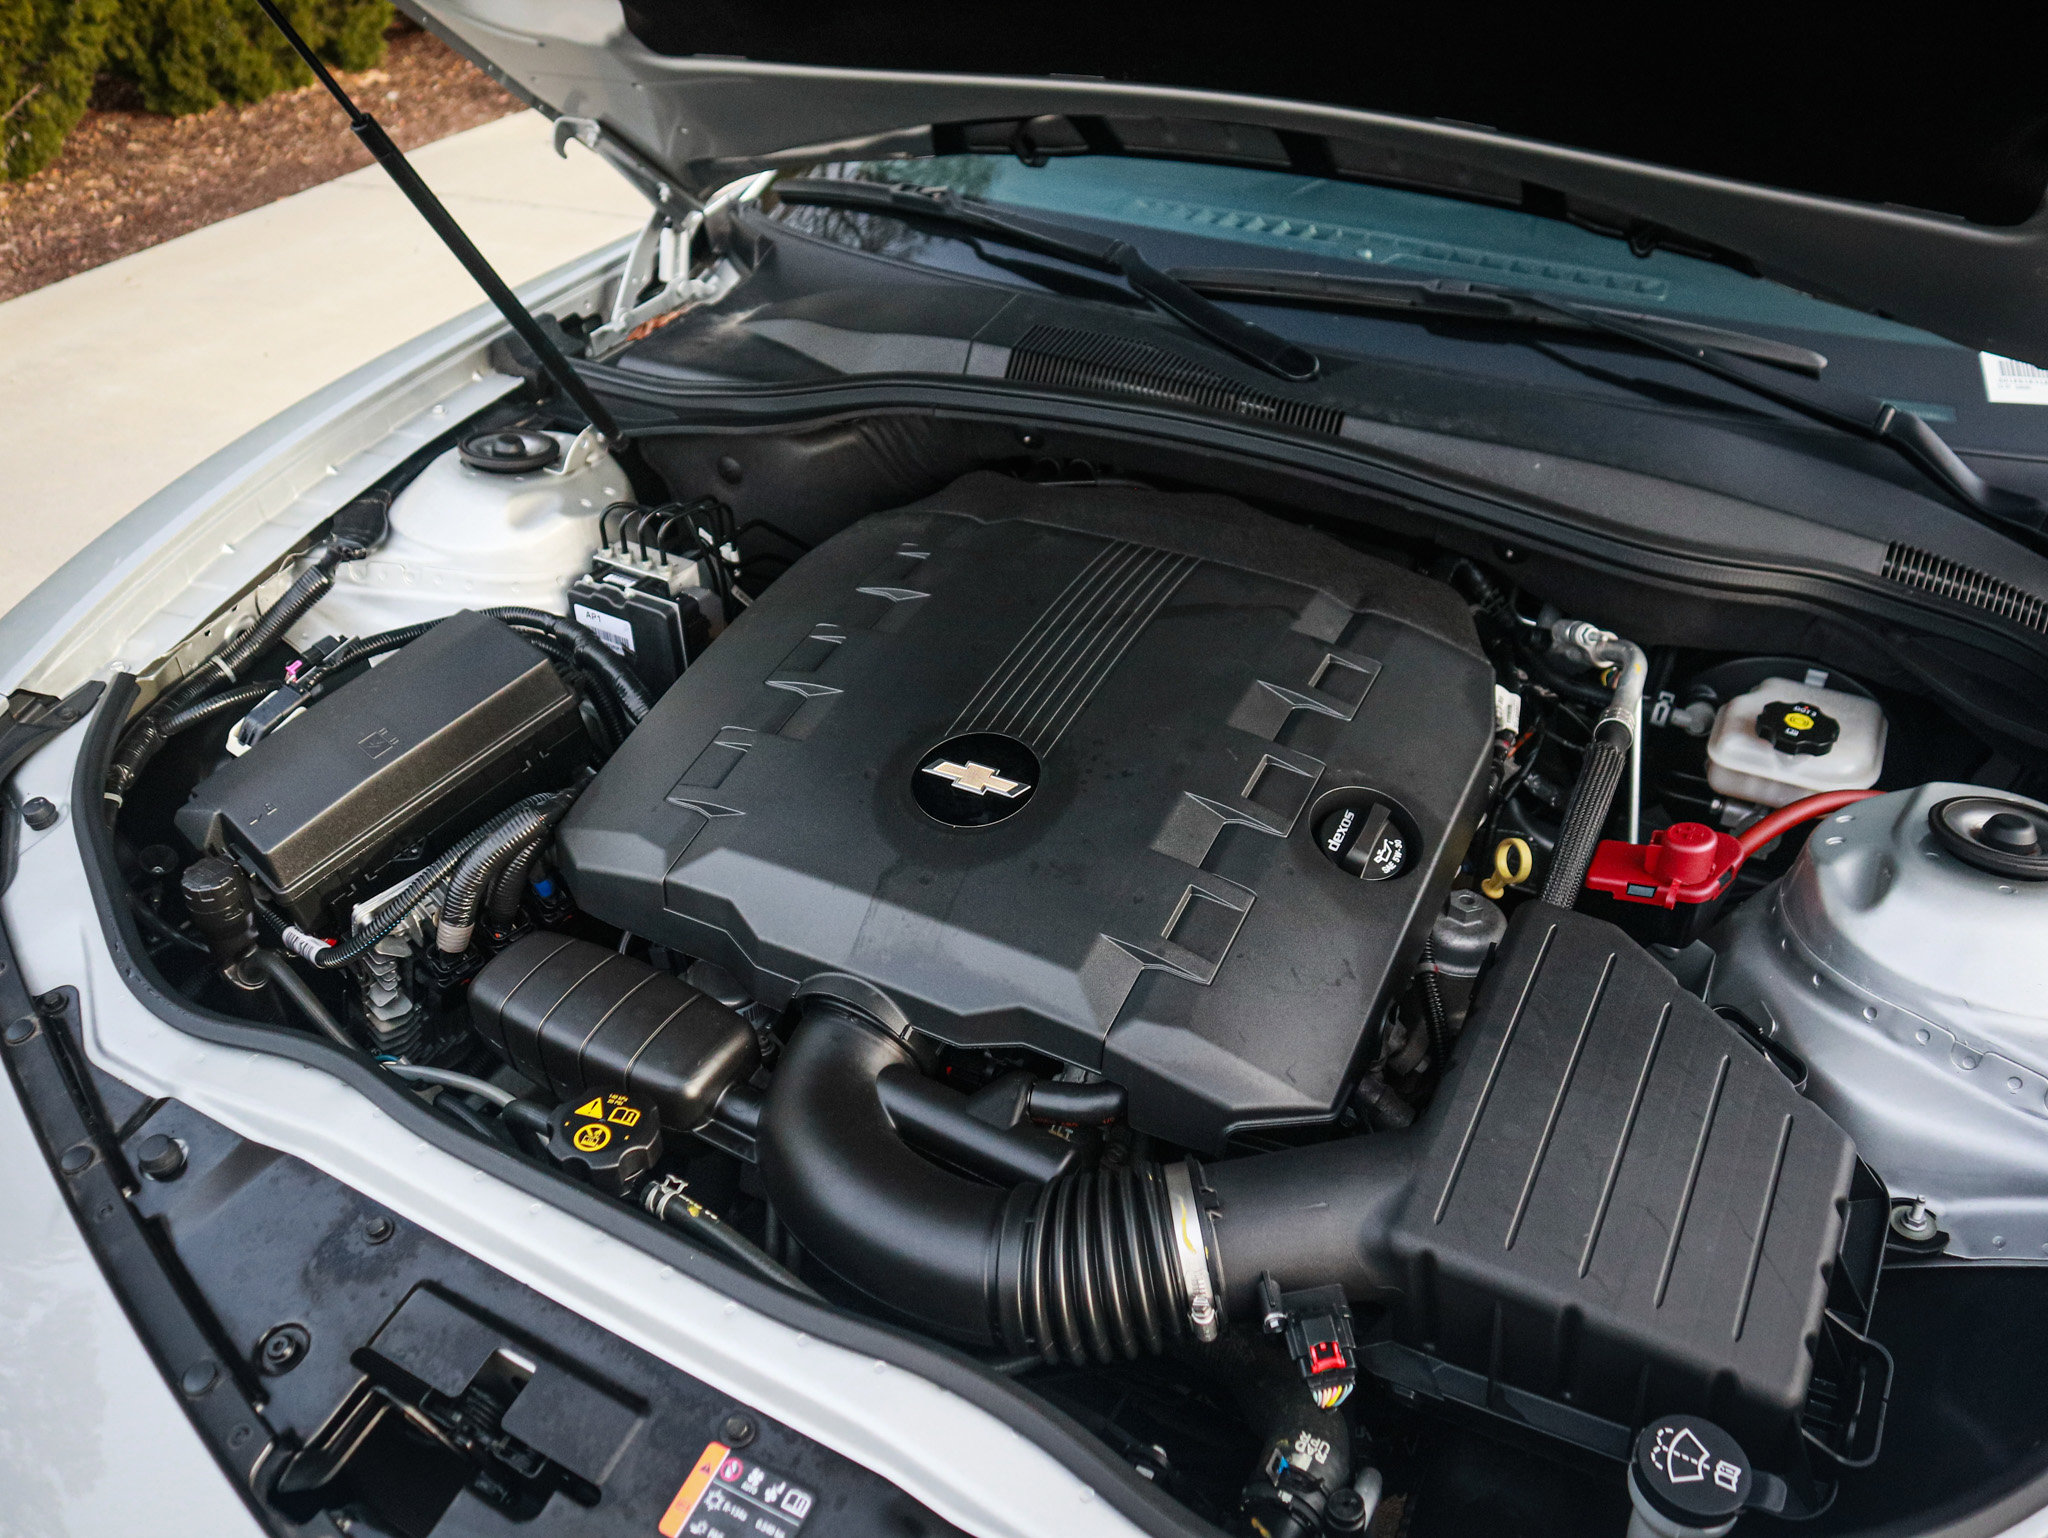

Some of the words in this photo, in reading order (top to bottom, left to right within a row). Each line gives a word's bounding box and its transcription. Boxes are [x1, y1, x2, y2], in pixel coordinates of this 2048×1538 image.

[586, 611, 601, 622] AP1
[1328, 809, 1354, 851] dexos
[1381, 861, 1396, 874] SAE
[1392, 839, 1403, 863] 5W-30
